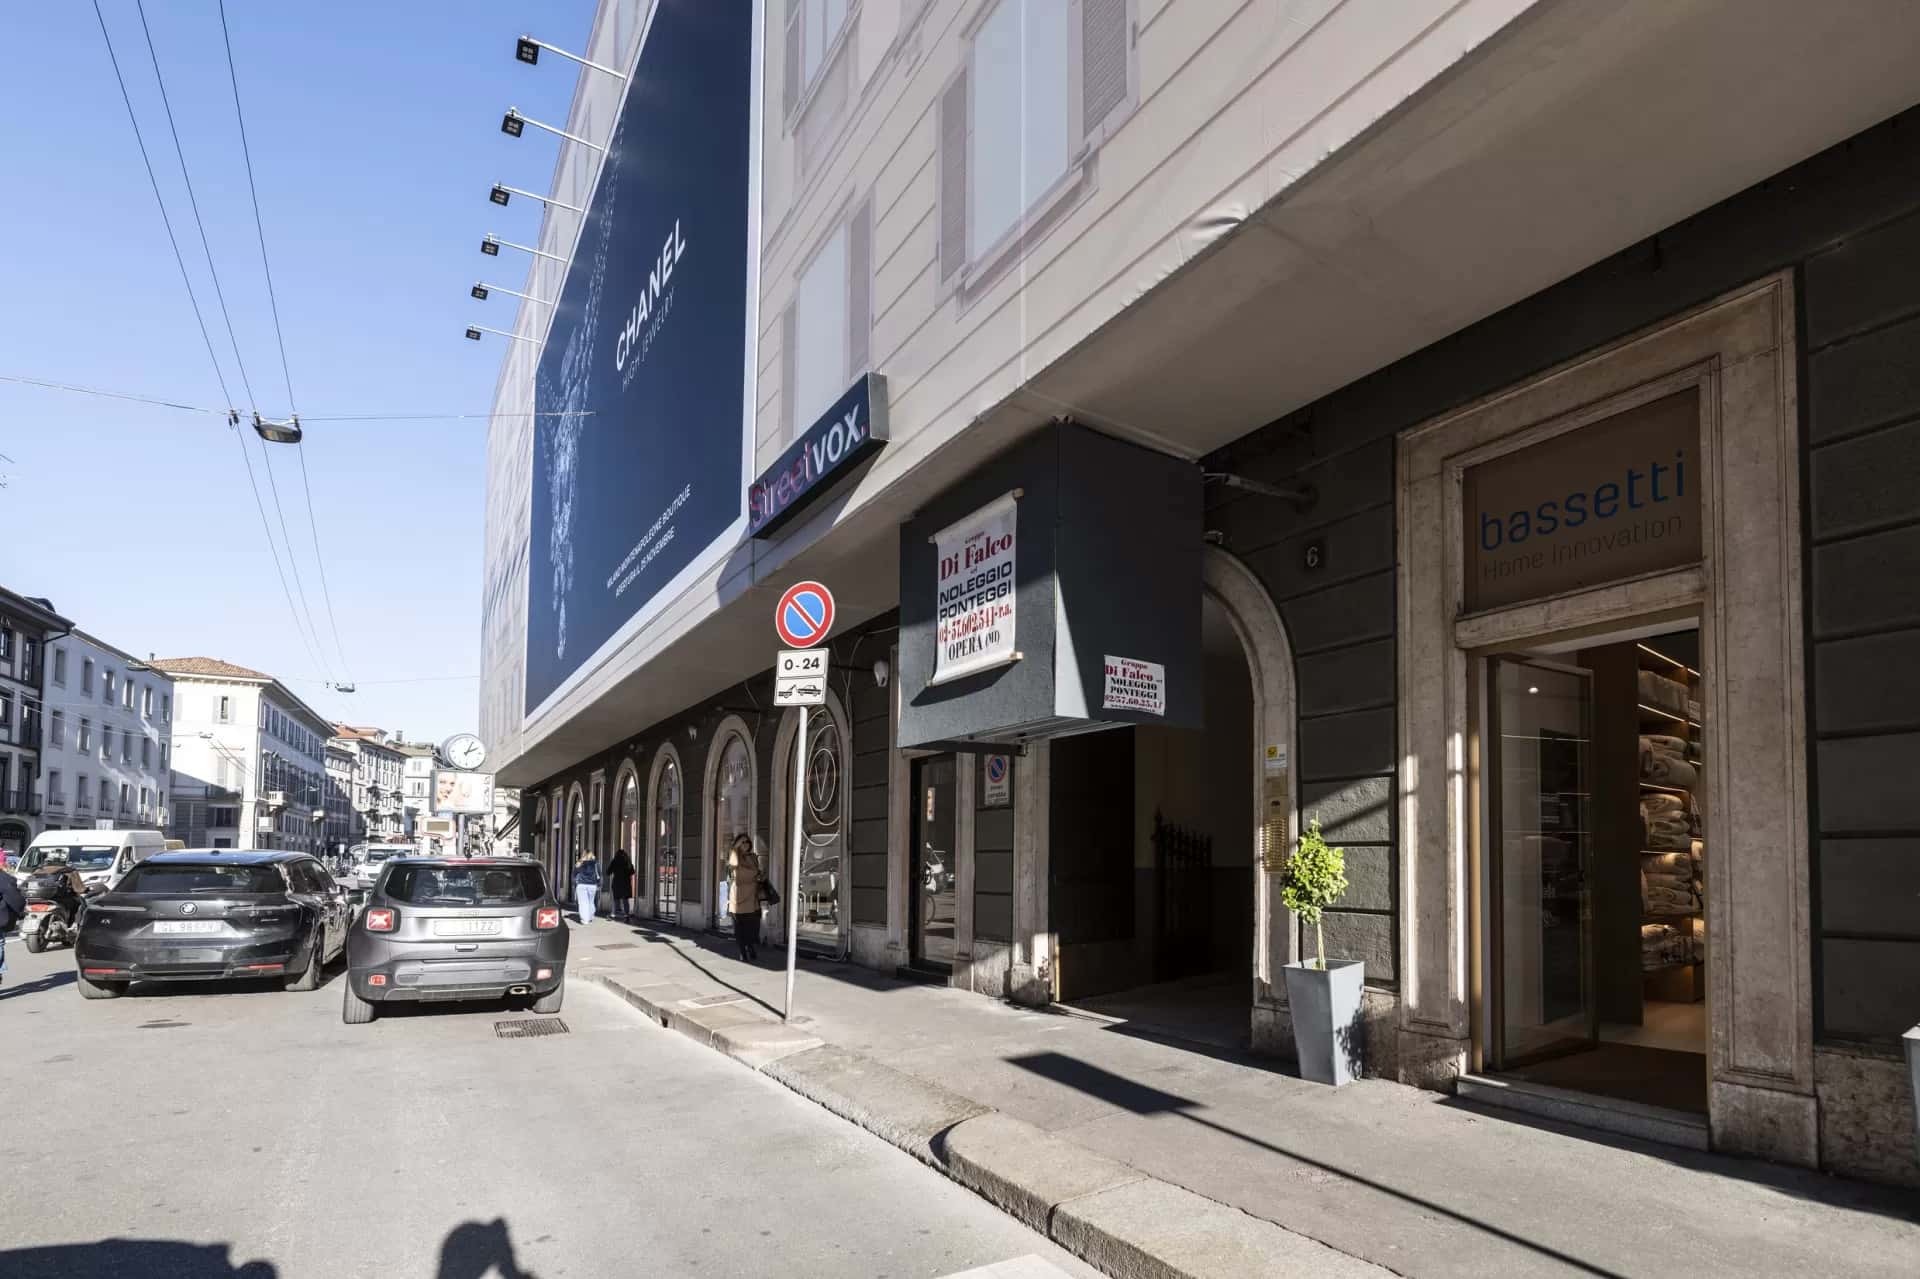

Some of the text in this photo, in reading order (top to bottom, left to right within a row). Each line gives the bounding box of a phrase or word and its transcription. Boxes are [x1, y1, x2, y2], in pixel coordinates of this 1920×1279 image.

[616, 217, 687, 372] CHANEL
[622, 352, 640, 393] HIGH
[662, 483, 691, 526] BOUTIQUE
[1480, 449, 1685, 551] bassetti
[940, 533, 1013, 581] Di Falco
[1306, 546, 1319, 568] 6
[1483, 514, 1683, 582] Home Innovation
[939, 560, 1013, 606] NOLEGGIO
[939, 579, 1012, 623] PONTEGGI
[948, 634, 983, 662] OPERA
[1104, 664, 1118, 677] Di
[1122, 667, 1153, 682] Falco
[1110, 676, 1158, 691] NOLEGGIO
[1110, 685, 1158, 700] PONTEGGI
